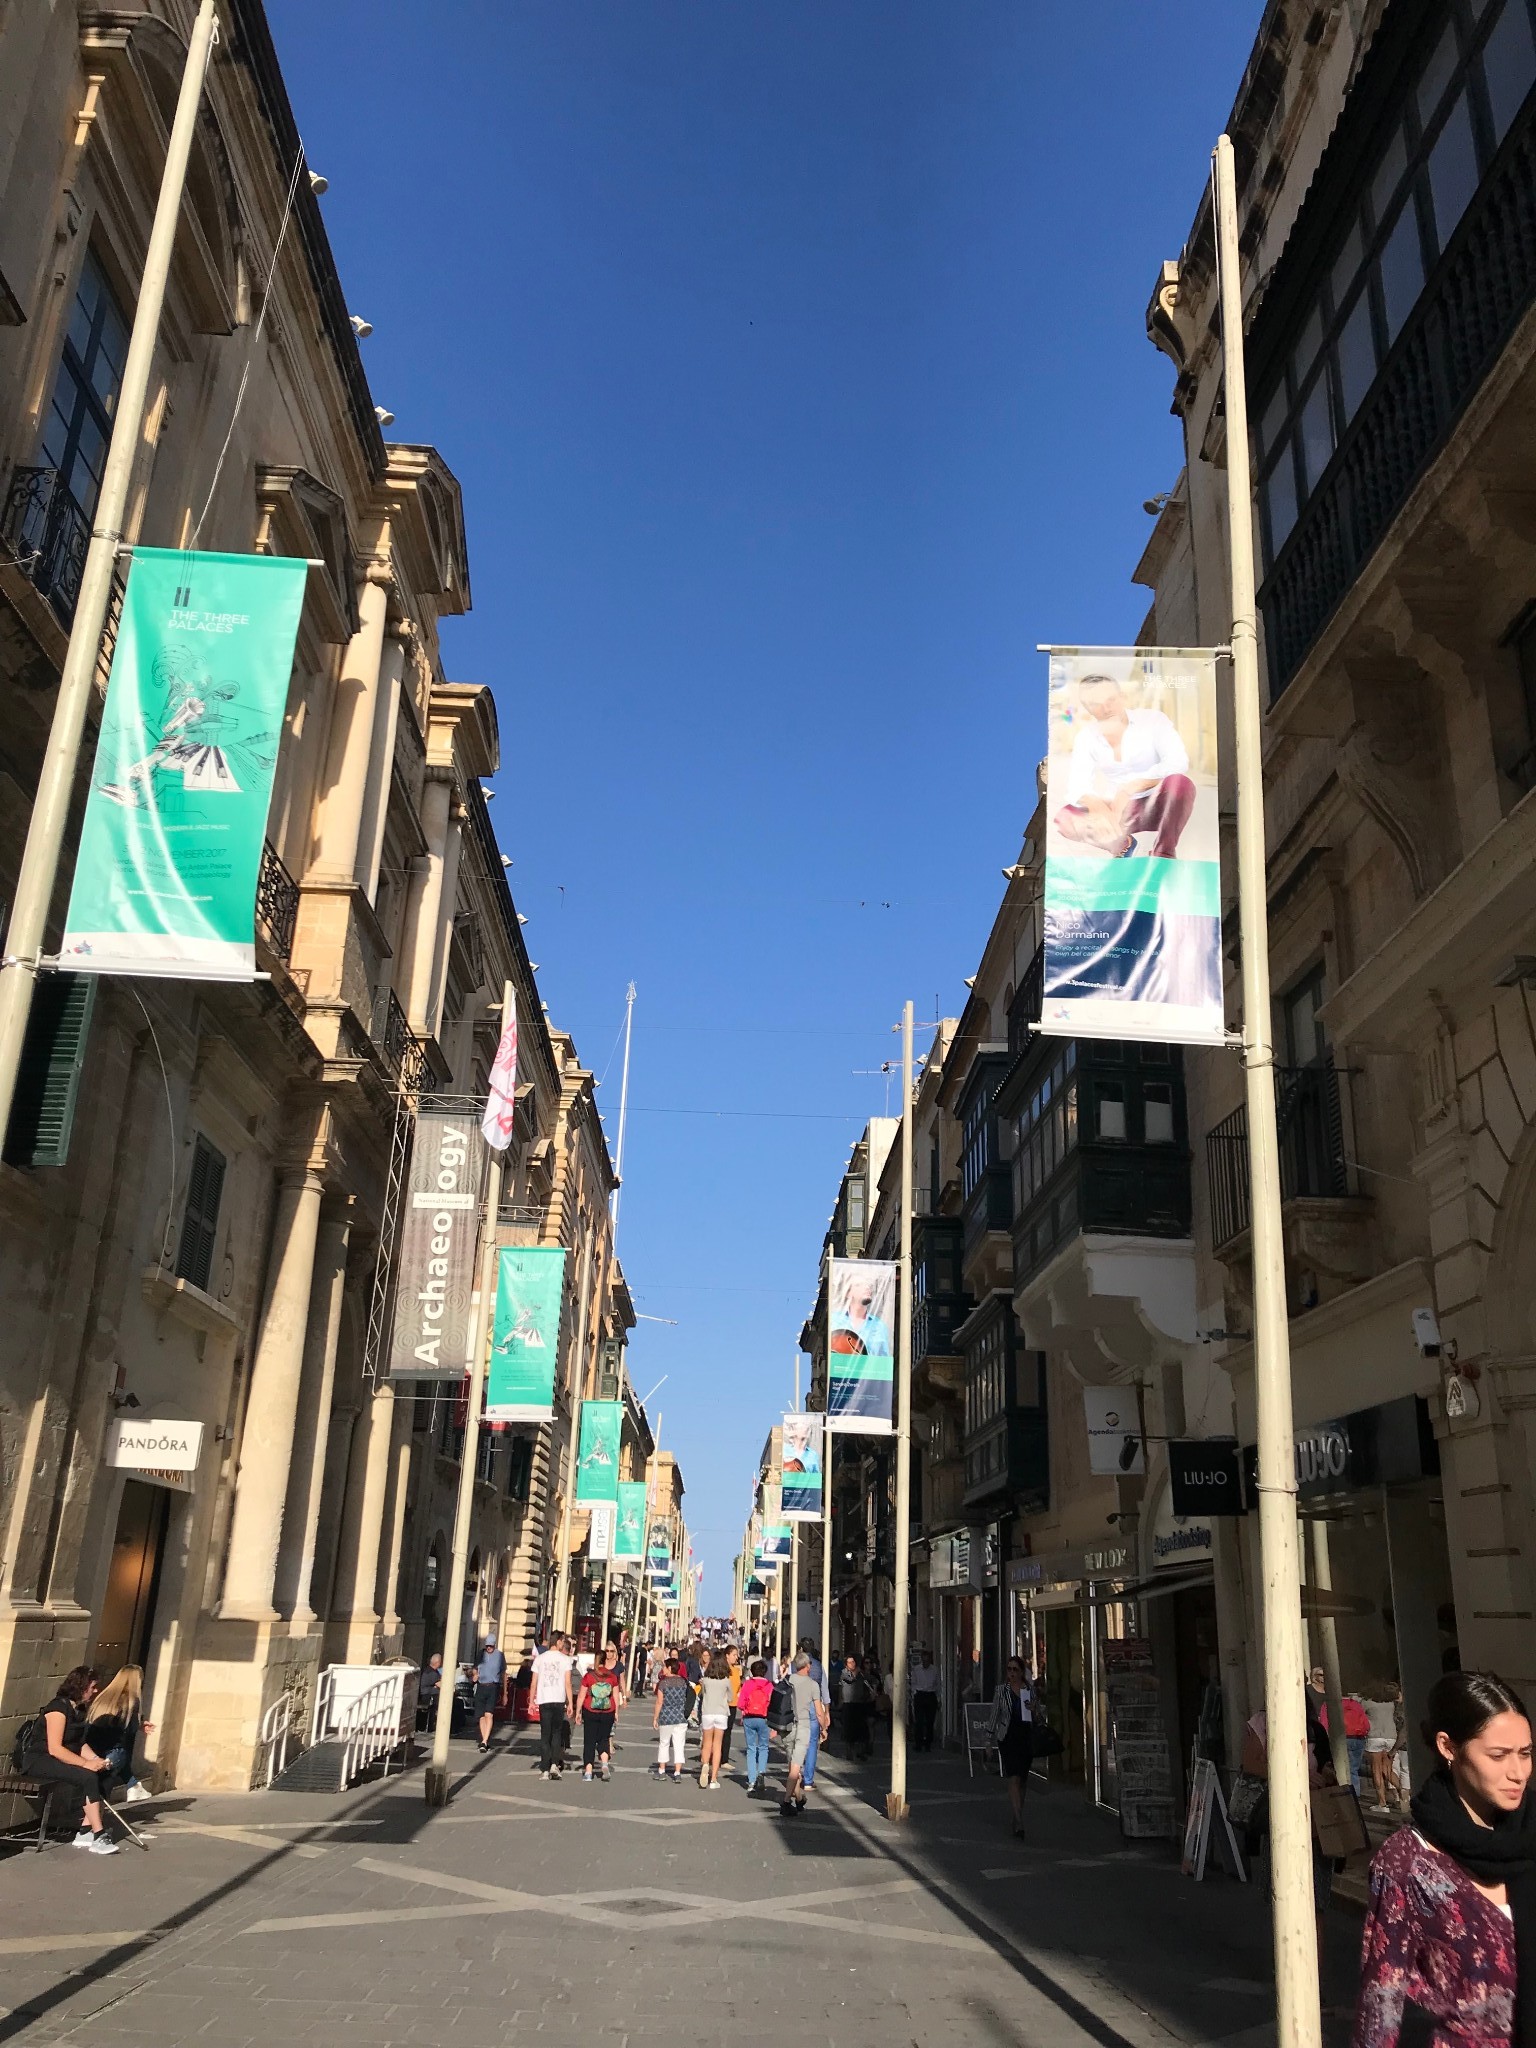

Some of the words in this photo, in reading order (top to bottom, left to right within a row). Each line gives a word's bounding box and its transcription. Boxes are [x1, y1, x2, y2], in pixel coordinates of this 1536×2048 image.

[171, 610, 199, 621] THE
[203, 612, 250, 625] THREE
[168, 620, 234, 633] PALACES
[149, 848, 204, 860] NOEMBER
[1056, 920, 1081, 930] Nico
[1056, 930, 1110, 940] Darmanin
[118, 1435, 188, 1451] PANDORA
